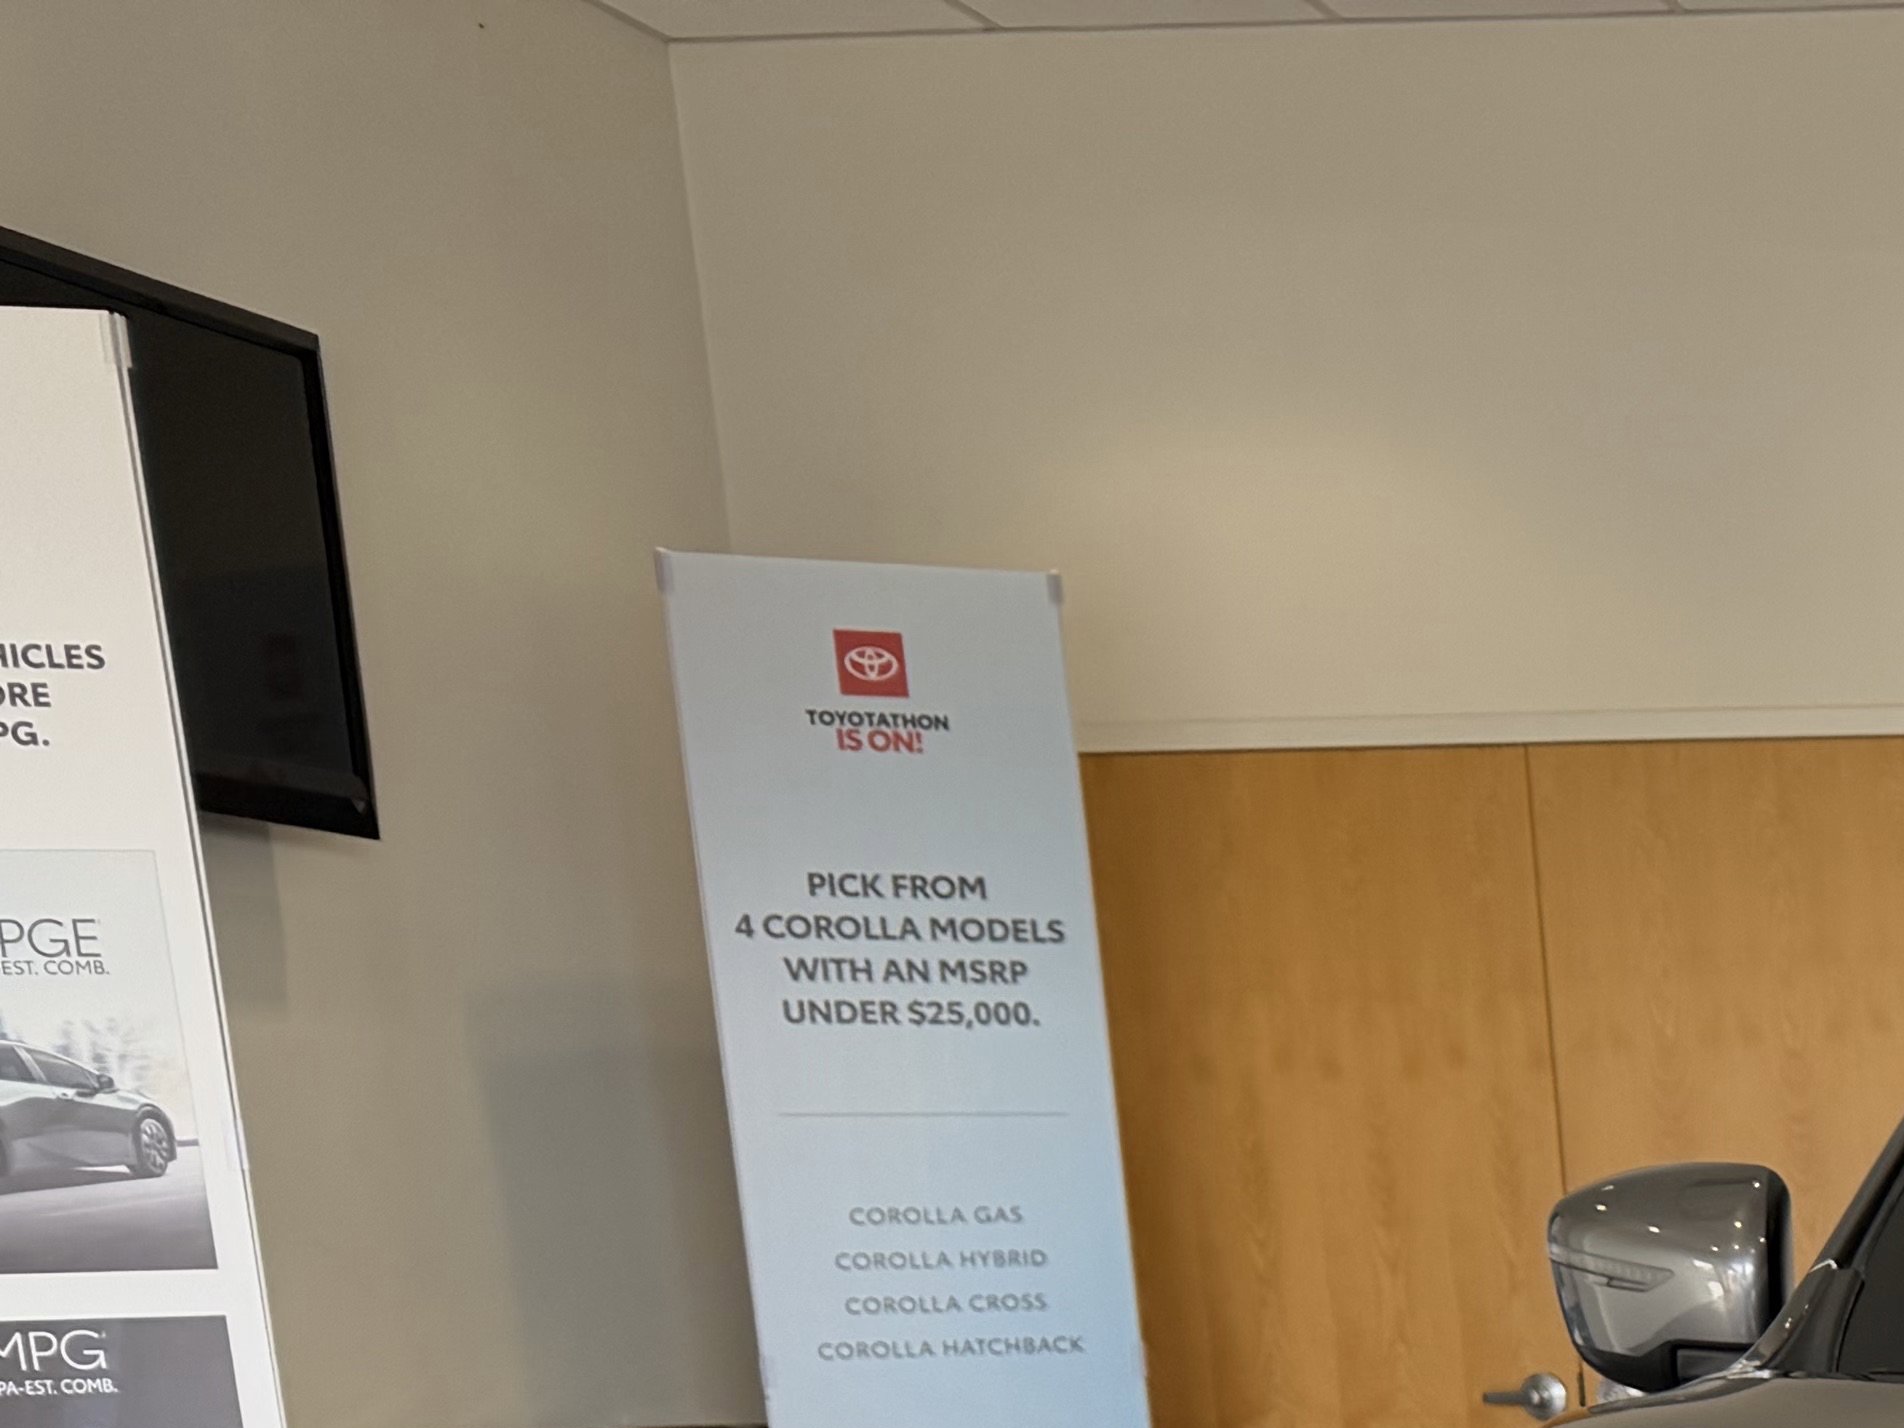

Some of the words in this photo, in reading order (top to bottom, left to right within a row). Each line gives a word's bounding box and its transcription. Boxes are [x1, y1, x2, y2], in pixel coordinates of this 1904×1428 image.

[805, 709, 950, 731] TOYOTATHON
[835, 728, 863, 751] IS
[867, 729, 924, 754] ON!
[806, 871, 881, 899] PICK
[891, 874, 988, 901] FROM
[735, 913, 755, 939] 4
[763, 914, 922, 942] COROLLA
[930, 917, 1066, 944] MODELS
[43, 959, 111, 976] COMB.
[783, 957, 878, 983] WITH
[882, 958, 930, 984] AN
[938, 959, 1029, 985] MSRP
[782, 999, 901, 1026] UNDER
[907, 999, 1041, 1030] $25,000.
[848, 1206, 967, 1226] COROLLA
[973, 1205, 1024, 1225] GAS
[835, 1250, 951, 1271] COROLLA
[959, 1249, 1049, 1269] HYBRID
[845, 1295, 962, 1316] COROLLA
[968, 1293, 1047, 1313] CROSS
[818, 1340, 935, 1361] COROLLA
[943, 1335, 1086, 1357] HATCHBACK
[60, 1377, 120, 1395] COMB.
